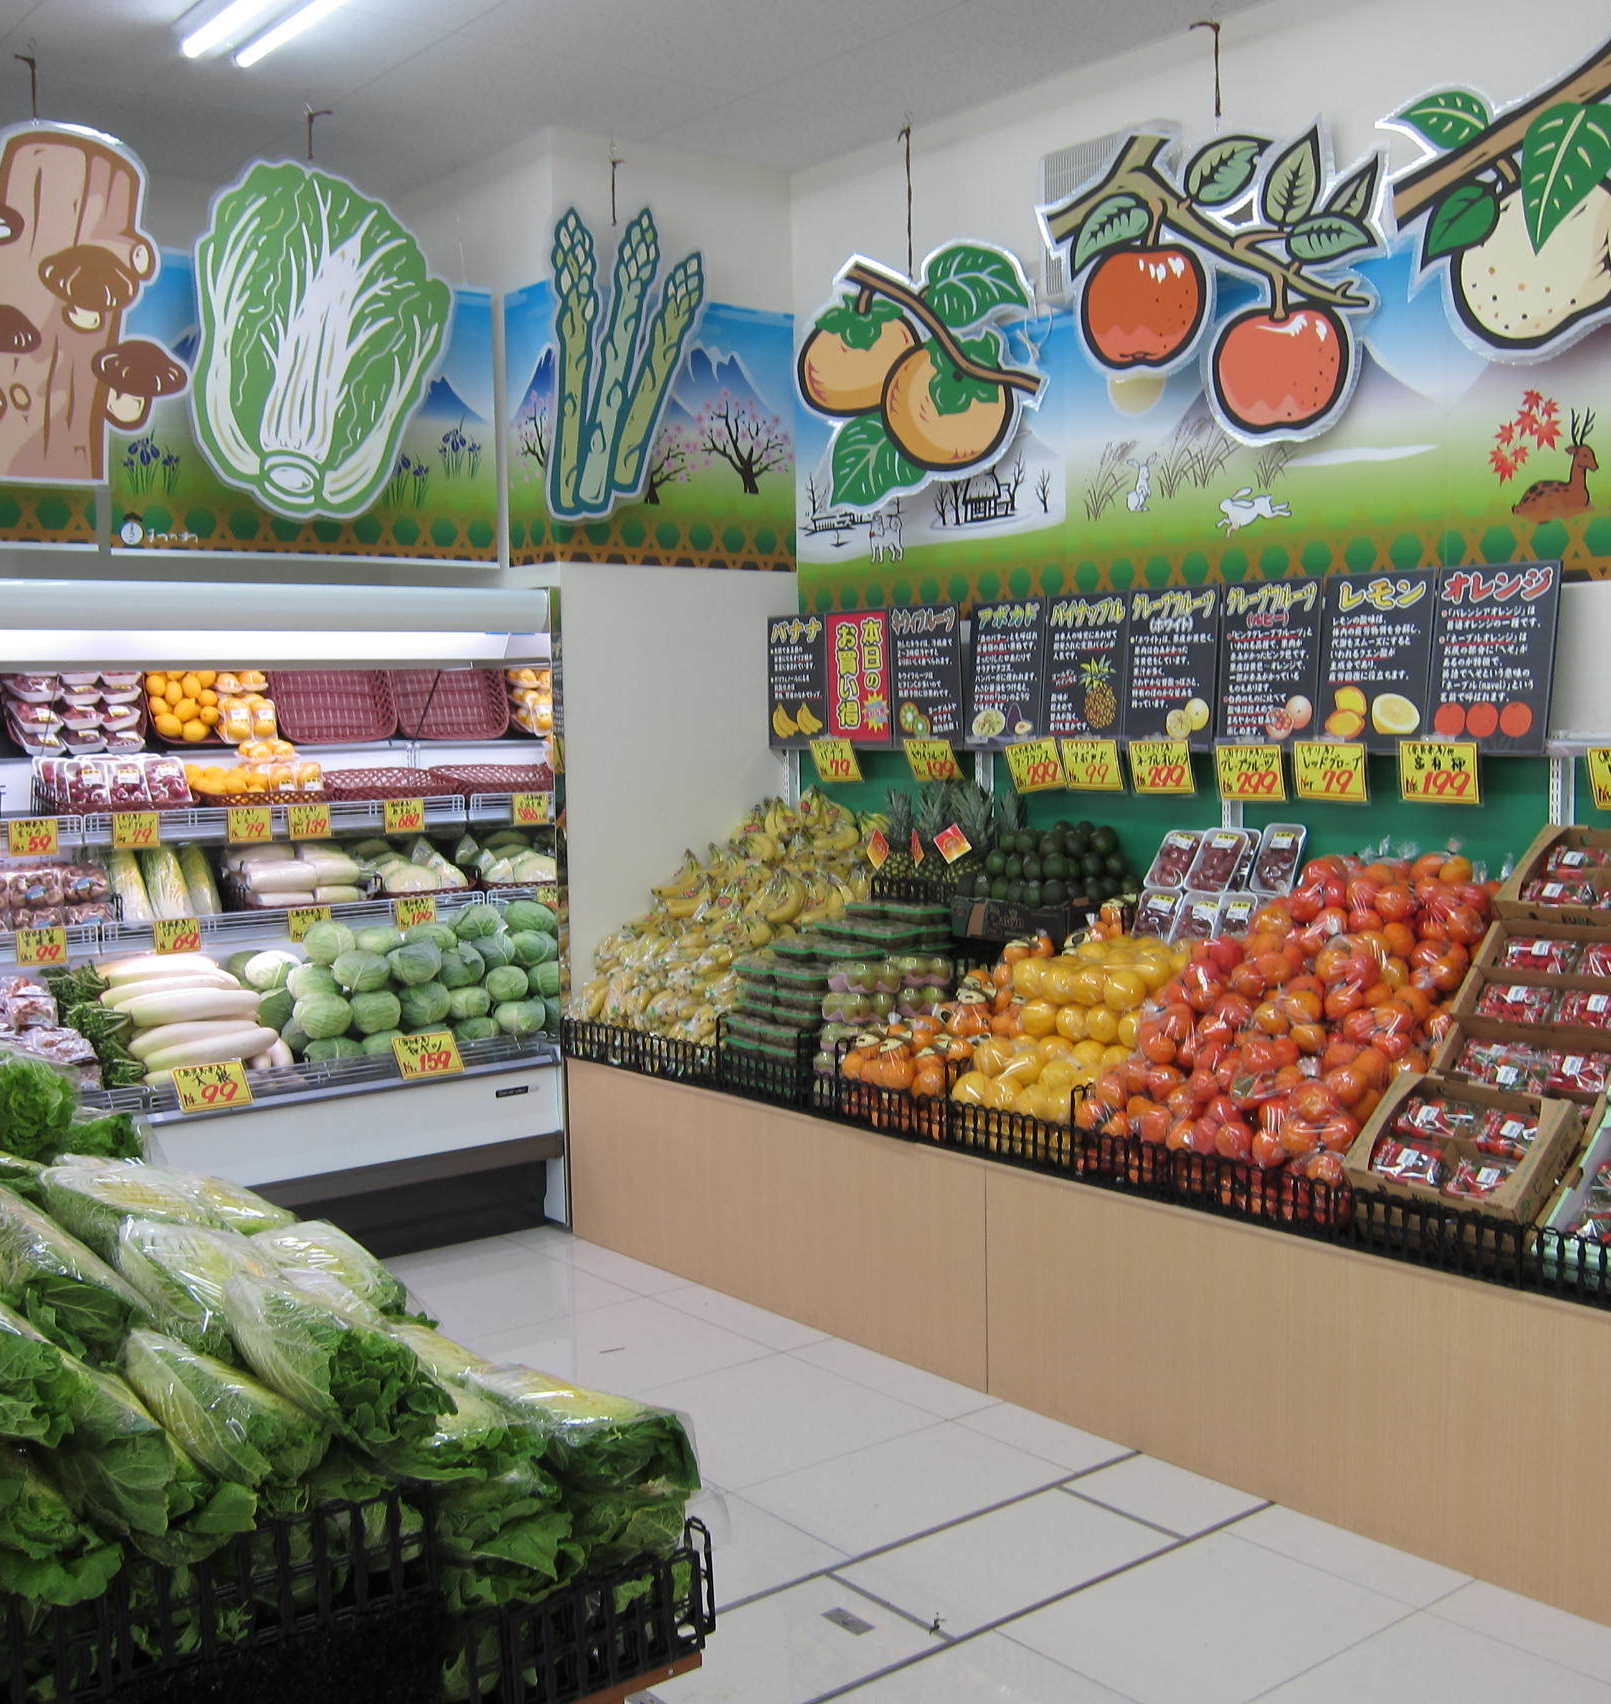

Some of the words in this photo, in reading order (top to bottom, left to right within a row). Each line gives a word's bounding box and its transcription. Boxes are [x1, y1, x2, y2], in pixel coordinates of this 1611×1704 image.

[1338, 577, 1426, 612] レモン
[1441, 566, 1554, 605] オレンジ
[1132, 589, 1216, 621] グレープフルーツ
[1226, 581, 1318, 616] グレープフルーツ
[891, 606, 956, 636] キウイフルーツ
[978, 602, 1040, 630] アボカド
[1050, 596, 1126, 628] パイナップル
[1246, 610, 1289, 627] (ルビー)
[770, 616, 822, 644] バナナ
[1149, 616, 1194, 633] (ホワイト)
[860, 617, 883, 691] 本日の
[836, 621, 861, 730] お買い得
[829, 758, 851, 777] 79
[926, 760, 956, 777] 199
[1026, 760, 1060, 785] 299
[1085, 764, 1109, 784] 99
[1148, 765, 1186, 787] 299
[1236, 771, 1278, 794] 299
[1322, 769, 1354, 794] 79
[1422, 770, 1471, 796] 199
[132, 828, 152, 843] 79
[246, 822, 265, 837] 79
[305, 819, 327, 834] 139
[28, 835, 52, 852] 59
[35, 944, 62, 961] 99
[172, 932, 200, 951] 69
[407, 1040, 442, 1055] キャベツ
[419, 1051, 452, 1073] 159
[201, 1081, 239, 1103] 99
